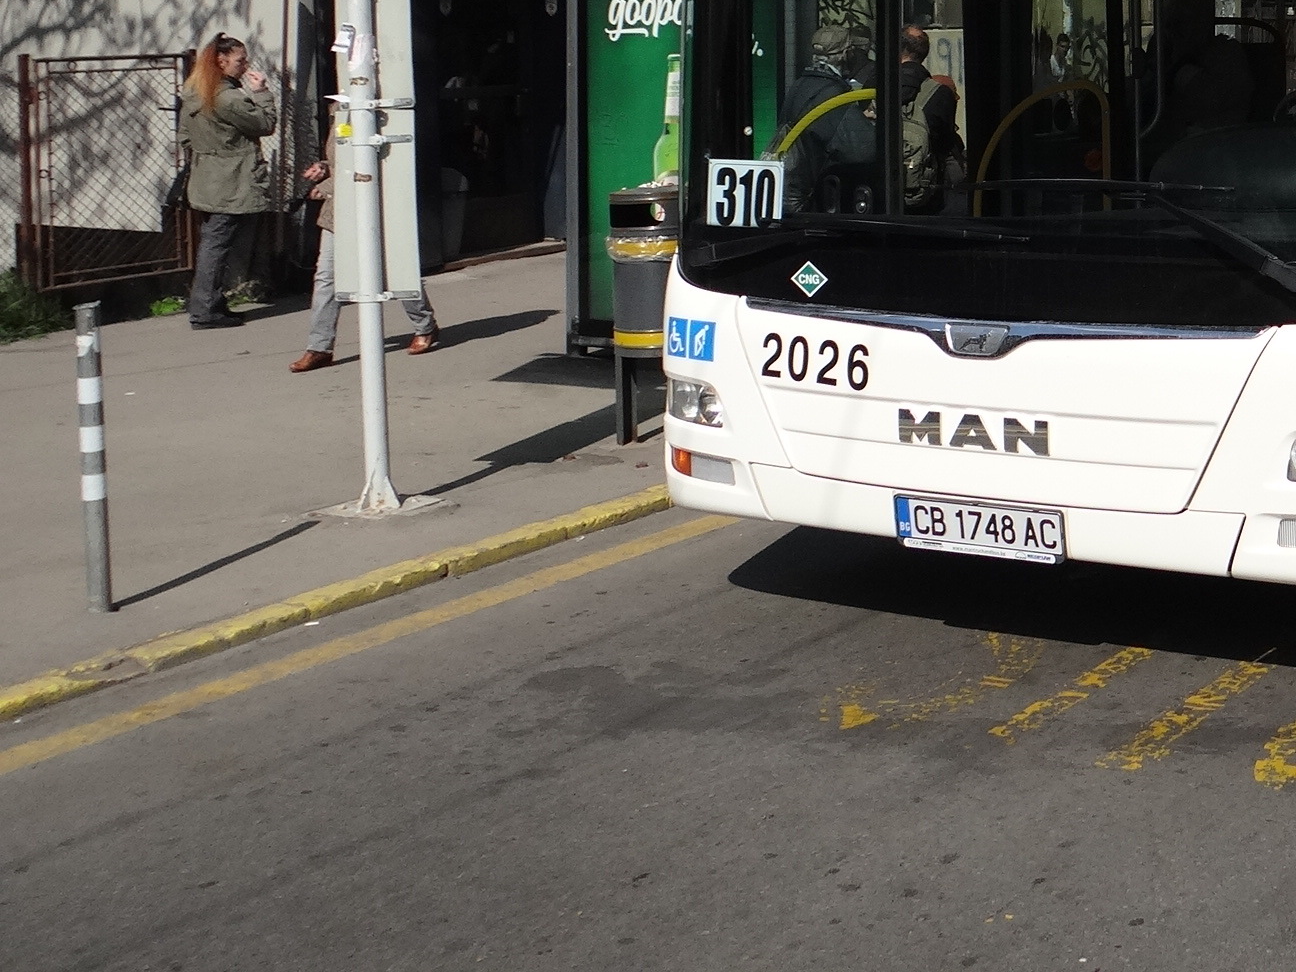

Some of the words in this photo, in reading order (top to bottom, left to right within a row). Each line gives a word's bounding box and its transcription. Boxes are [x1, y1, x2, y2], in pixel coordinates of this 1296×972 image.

[715, 167, 776, 228] 310
[798, 273, 820, 286] CNG
[762, 332, 870, 391] 2026
[898, 408, 1050, 457] MAN
[900, 521, 911, 532] BG
[955, 509, 1016, 545] 1748
